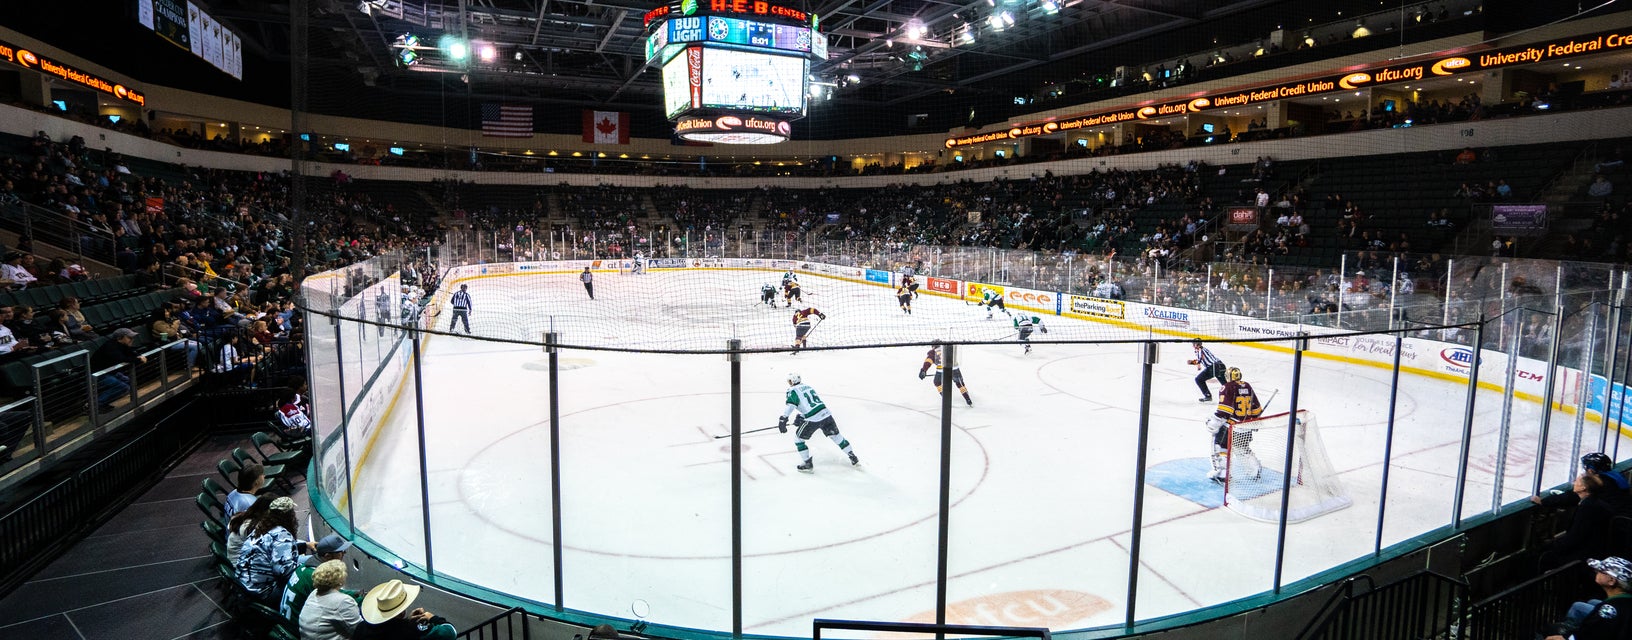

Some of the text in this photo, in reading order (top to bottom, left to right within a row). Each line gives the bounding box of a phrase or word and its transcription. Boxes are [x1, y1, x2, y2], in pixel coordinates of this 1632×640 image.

[711, 0, 806, 20] H-E-B CENTER
[676, 17, 700, 30] BUD
[672, 29, 702, 42] LIGHT
[752, 36, 768, 46] 8:01
[1480, 48, 1544, 67] University
[1548, 36, 1602, 57] Federal
[1446, 58, 1466, 67] ufcu
[41, 58, 67, 80] University
[68, 68, 85, 83] Federal
[86, 75, 100, 88] Credit
[100, 80, 112, 92] Union
[1376, 66, 1423, 82] ufcu.org
[1214, 80, 1334, 107] University Federal Credit Union
[1158, 104, 1186, 114] ufcu.org
[692, 118, 712, 128] Union
[746, 117, 776, 132] ufcu.org
[1060, 112, 1134, 130] University Federal Credit Union
[957, 138, 972, 146] University
[1144, 306, 1188, 320] EXCALIBUR
[1239, 326, 1260, 334] THANK
[1370, 343, 1394, 356] local
